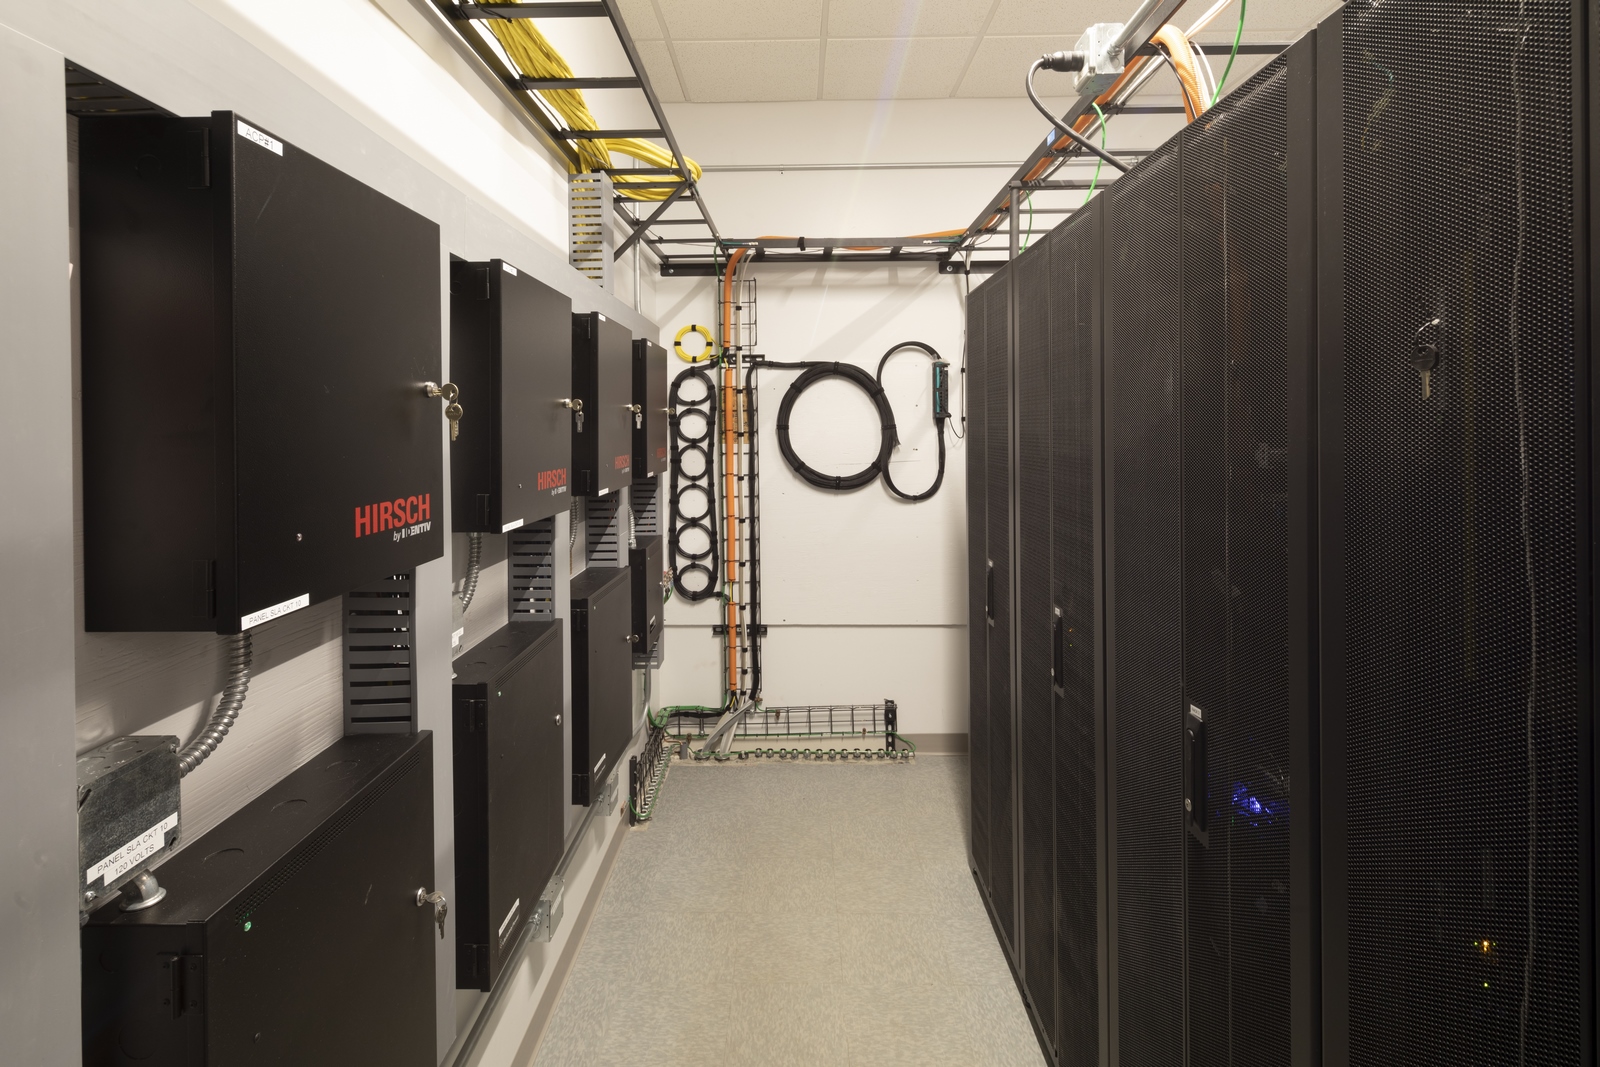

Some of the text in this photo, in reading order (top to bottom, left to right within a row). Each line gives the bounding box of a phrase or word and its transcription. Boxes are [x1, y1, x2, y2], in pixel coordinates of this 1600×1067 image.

[537, 468, 567, 491] HIRSCH
[355, 493, 430, 538] HIRSCH
[393, 530, 401, 542] by
[249, 612, 269, 625] PANEL
[270, 607, 282, 617] SLA
[282, 602, 294, 612] CKT
[97, 822, 168, 874] PANEL SLA CKT 10
[115, 843, 154, 875] 120 VOLTS
